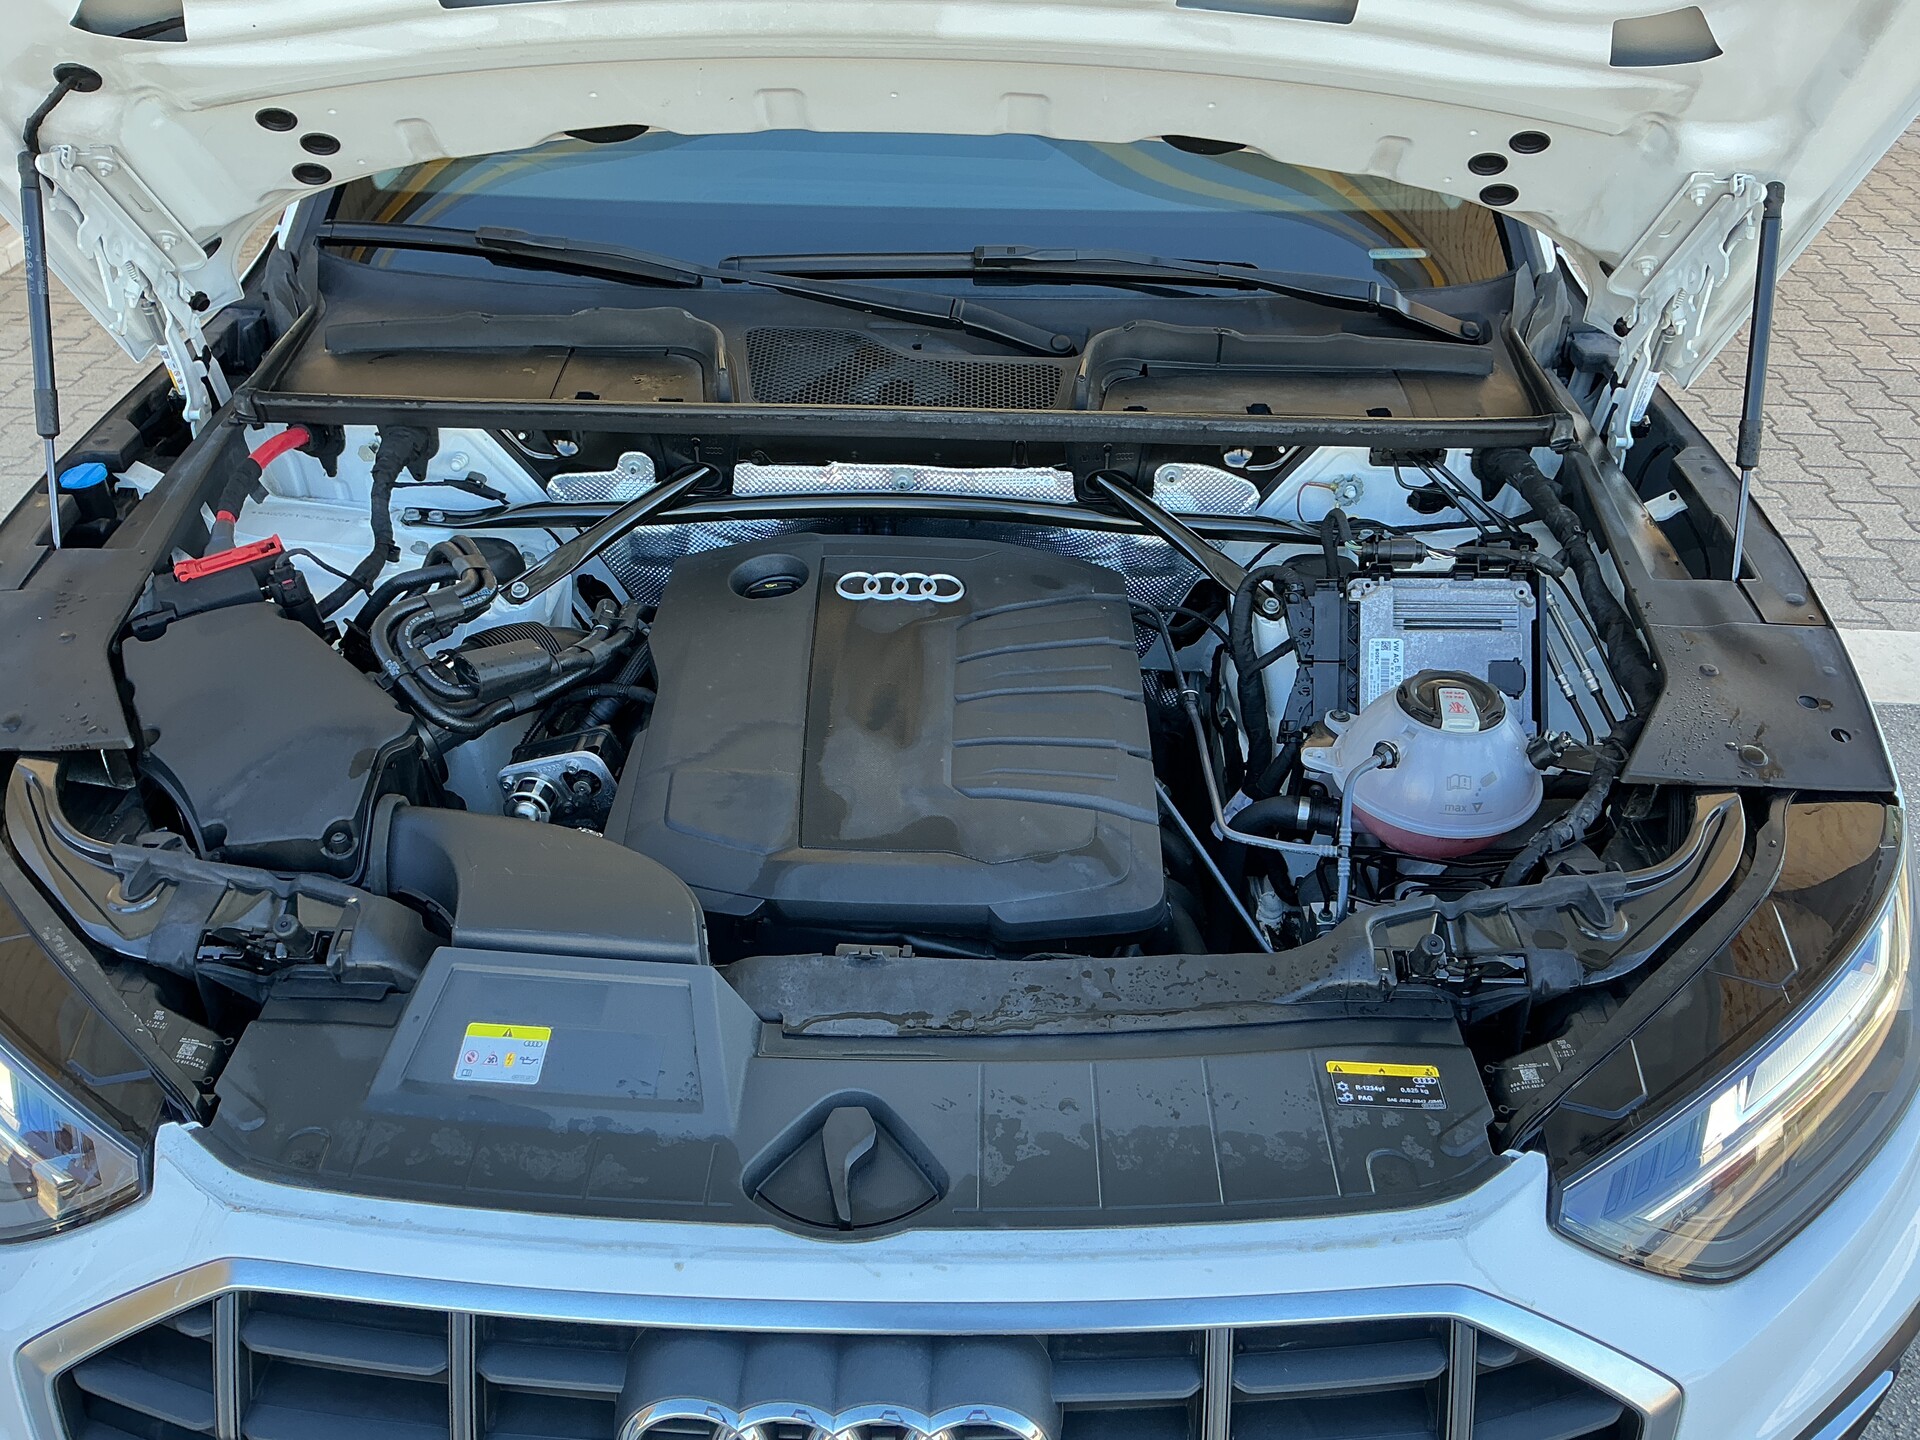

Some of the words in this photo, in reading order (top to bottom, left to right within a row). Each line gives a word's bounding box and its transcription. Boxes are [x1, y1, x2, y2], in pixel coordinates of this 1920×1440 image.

[1393, 640, 1399, 652] VW
[1393, 653, 1399, 663] AG
[1444, 803, 1467, 812] max
[1355, 1084, 1385, 1093] R-1234yf
